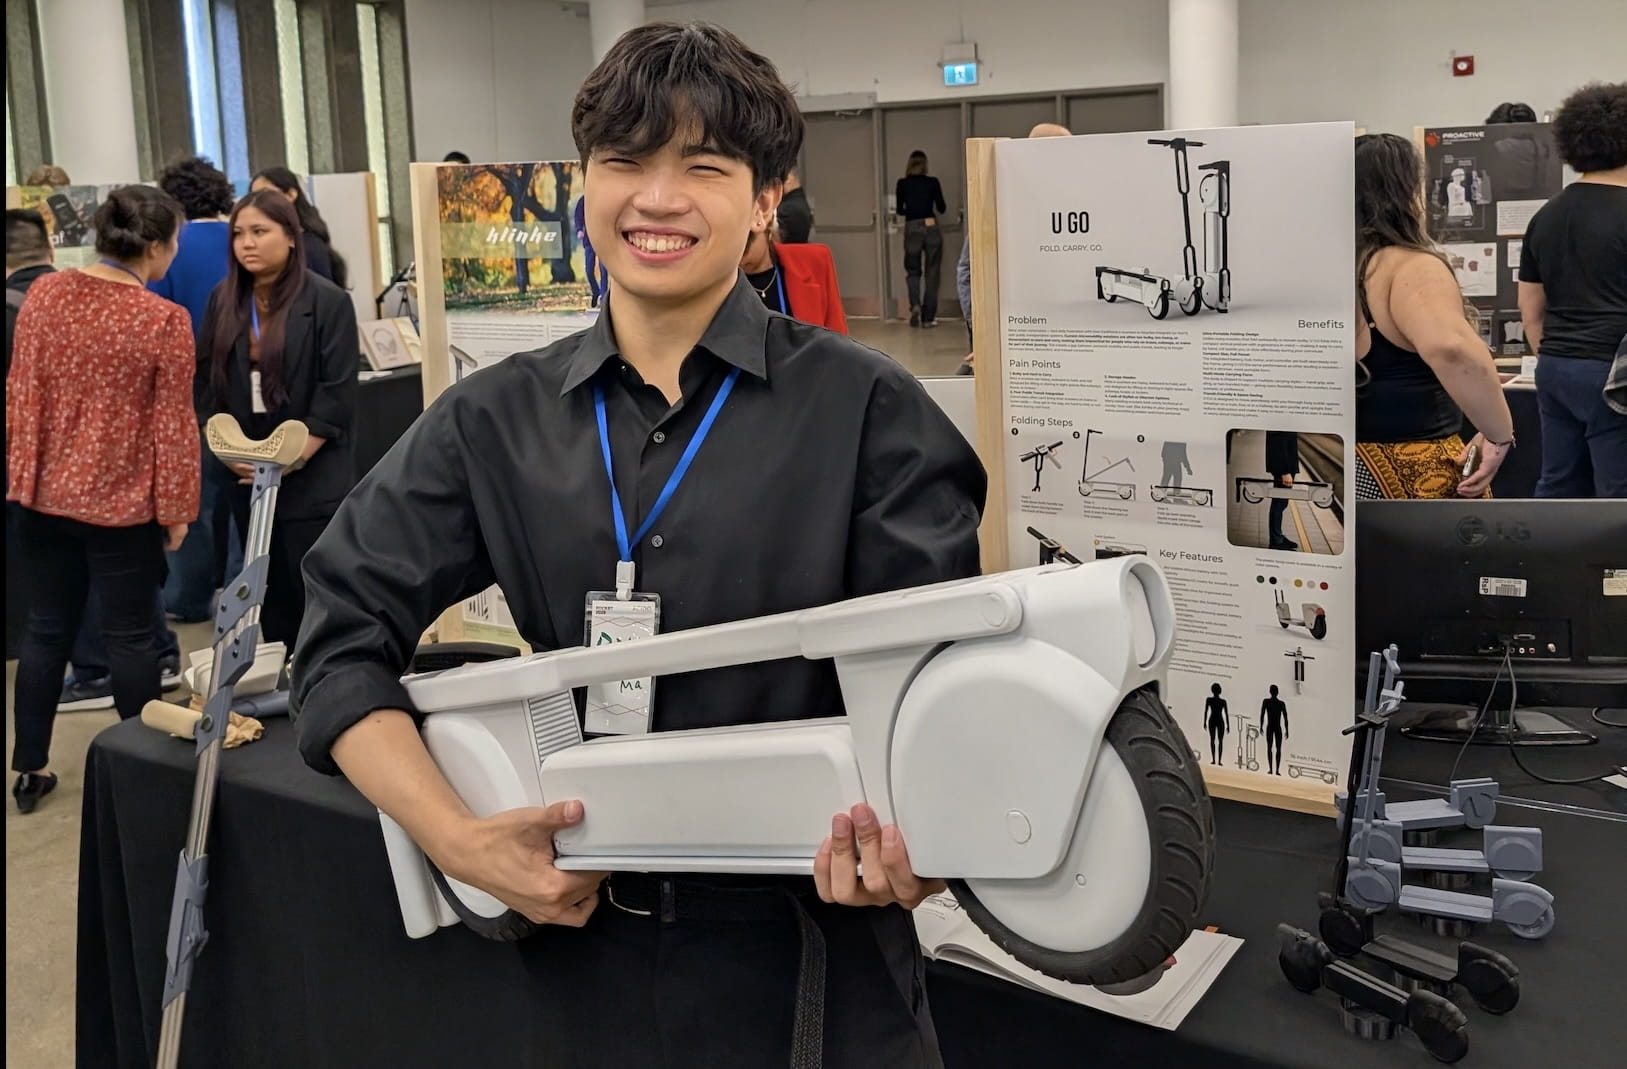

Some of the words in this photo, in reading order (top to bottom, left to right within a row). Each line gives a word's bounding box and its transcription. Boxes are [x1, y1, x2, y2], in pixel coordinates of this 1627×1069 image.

[1441, 131, 1485, 139] PROACTIVE
[1051, 212, 1062, 234] U
[1067, 211, 1090, 234] GO
[1008, 316, 1047, 325] Problem
[1298, 319, 1344, 329] Benefits
[1009, 359, 1029, 368] Pain
[1031, 360, 1061, 369] Points
[1011, 416, 1045, 427] Folding
[1047, 418, 1073, 428] Steps
[1159, 549, 1178, 560] Key
[1180, 551, 1224, 563] Features
[1481, 578, 1489, 594] RsP
[620, 680, 642, 693] Ma
